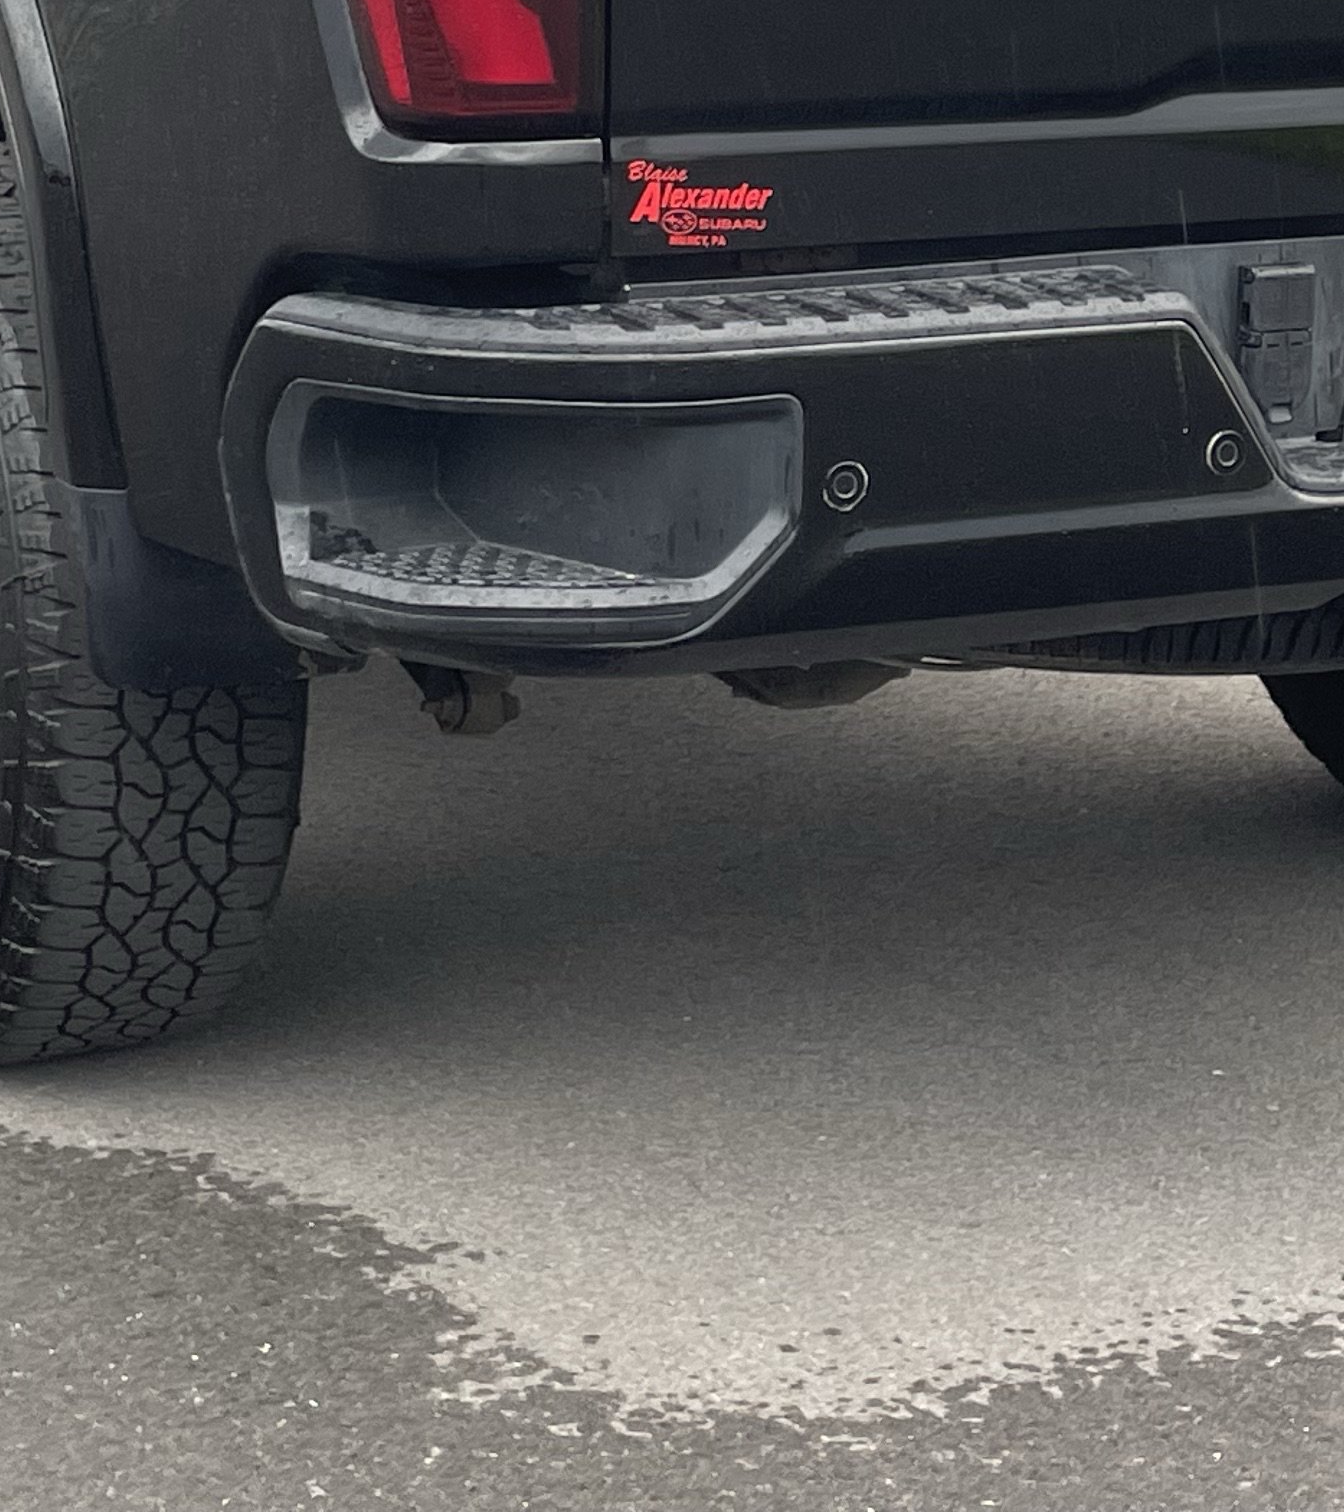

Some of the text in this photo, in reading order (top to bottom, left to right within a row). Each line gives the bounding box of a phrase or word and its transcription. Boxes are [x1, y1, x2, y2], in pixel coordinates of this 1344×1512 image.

[627, 160, 689, 183] Blaise
[629, 182, 773, 223] Alexander
[698, 219, 767, 231] SUBARU
[711, 234, 728, 246] PA
